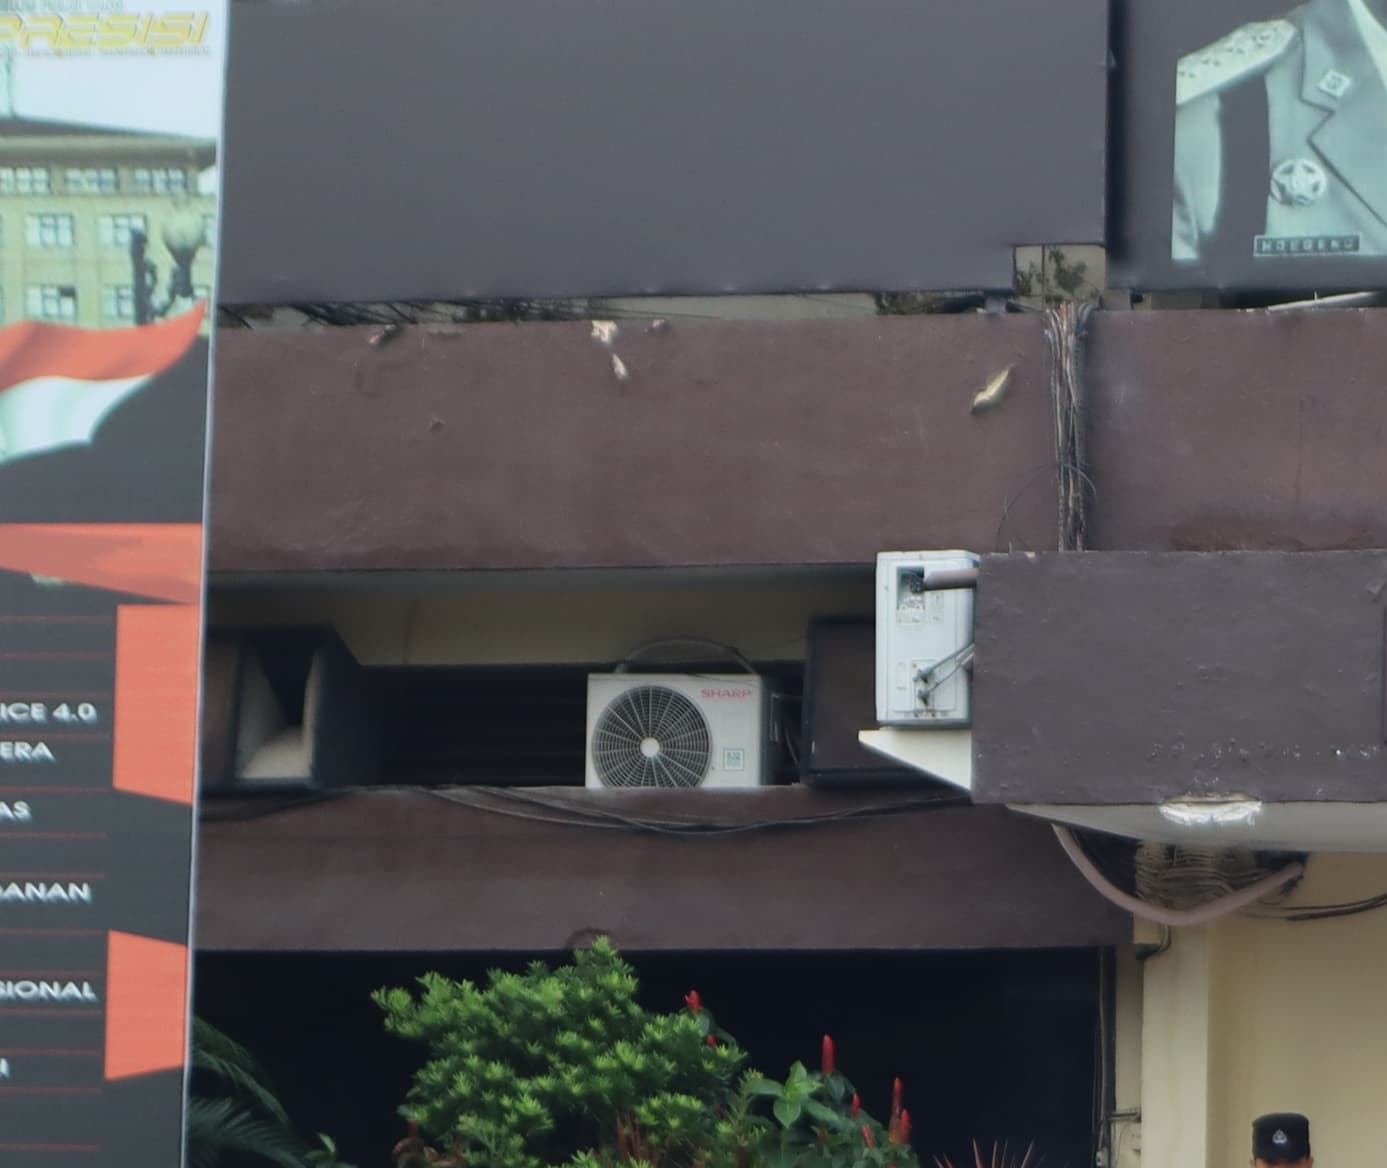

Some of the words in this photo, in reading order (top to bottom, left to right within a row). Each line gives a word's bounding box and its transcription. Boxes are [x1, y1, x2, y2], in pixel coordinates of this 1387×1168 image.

[701, 688, 752, 698] SHARP
[52, 703, 98, 723] 4.0
[0, 981, 97, 1001] IONAL
